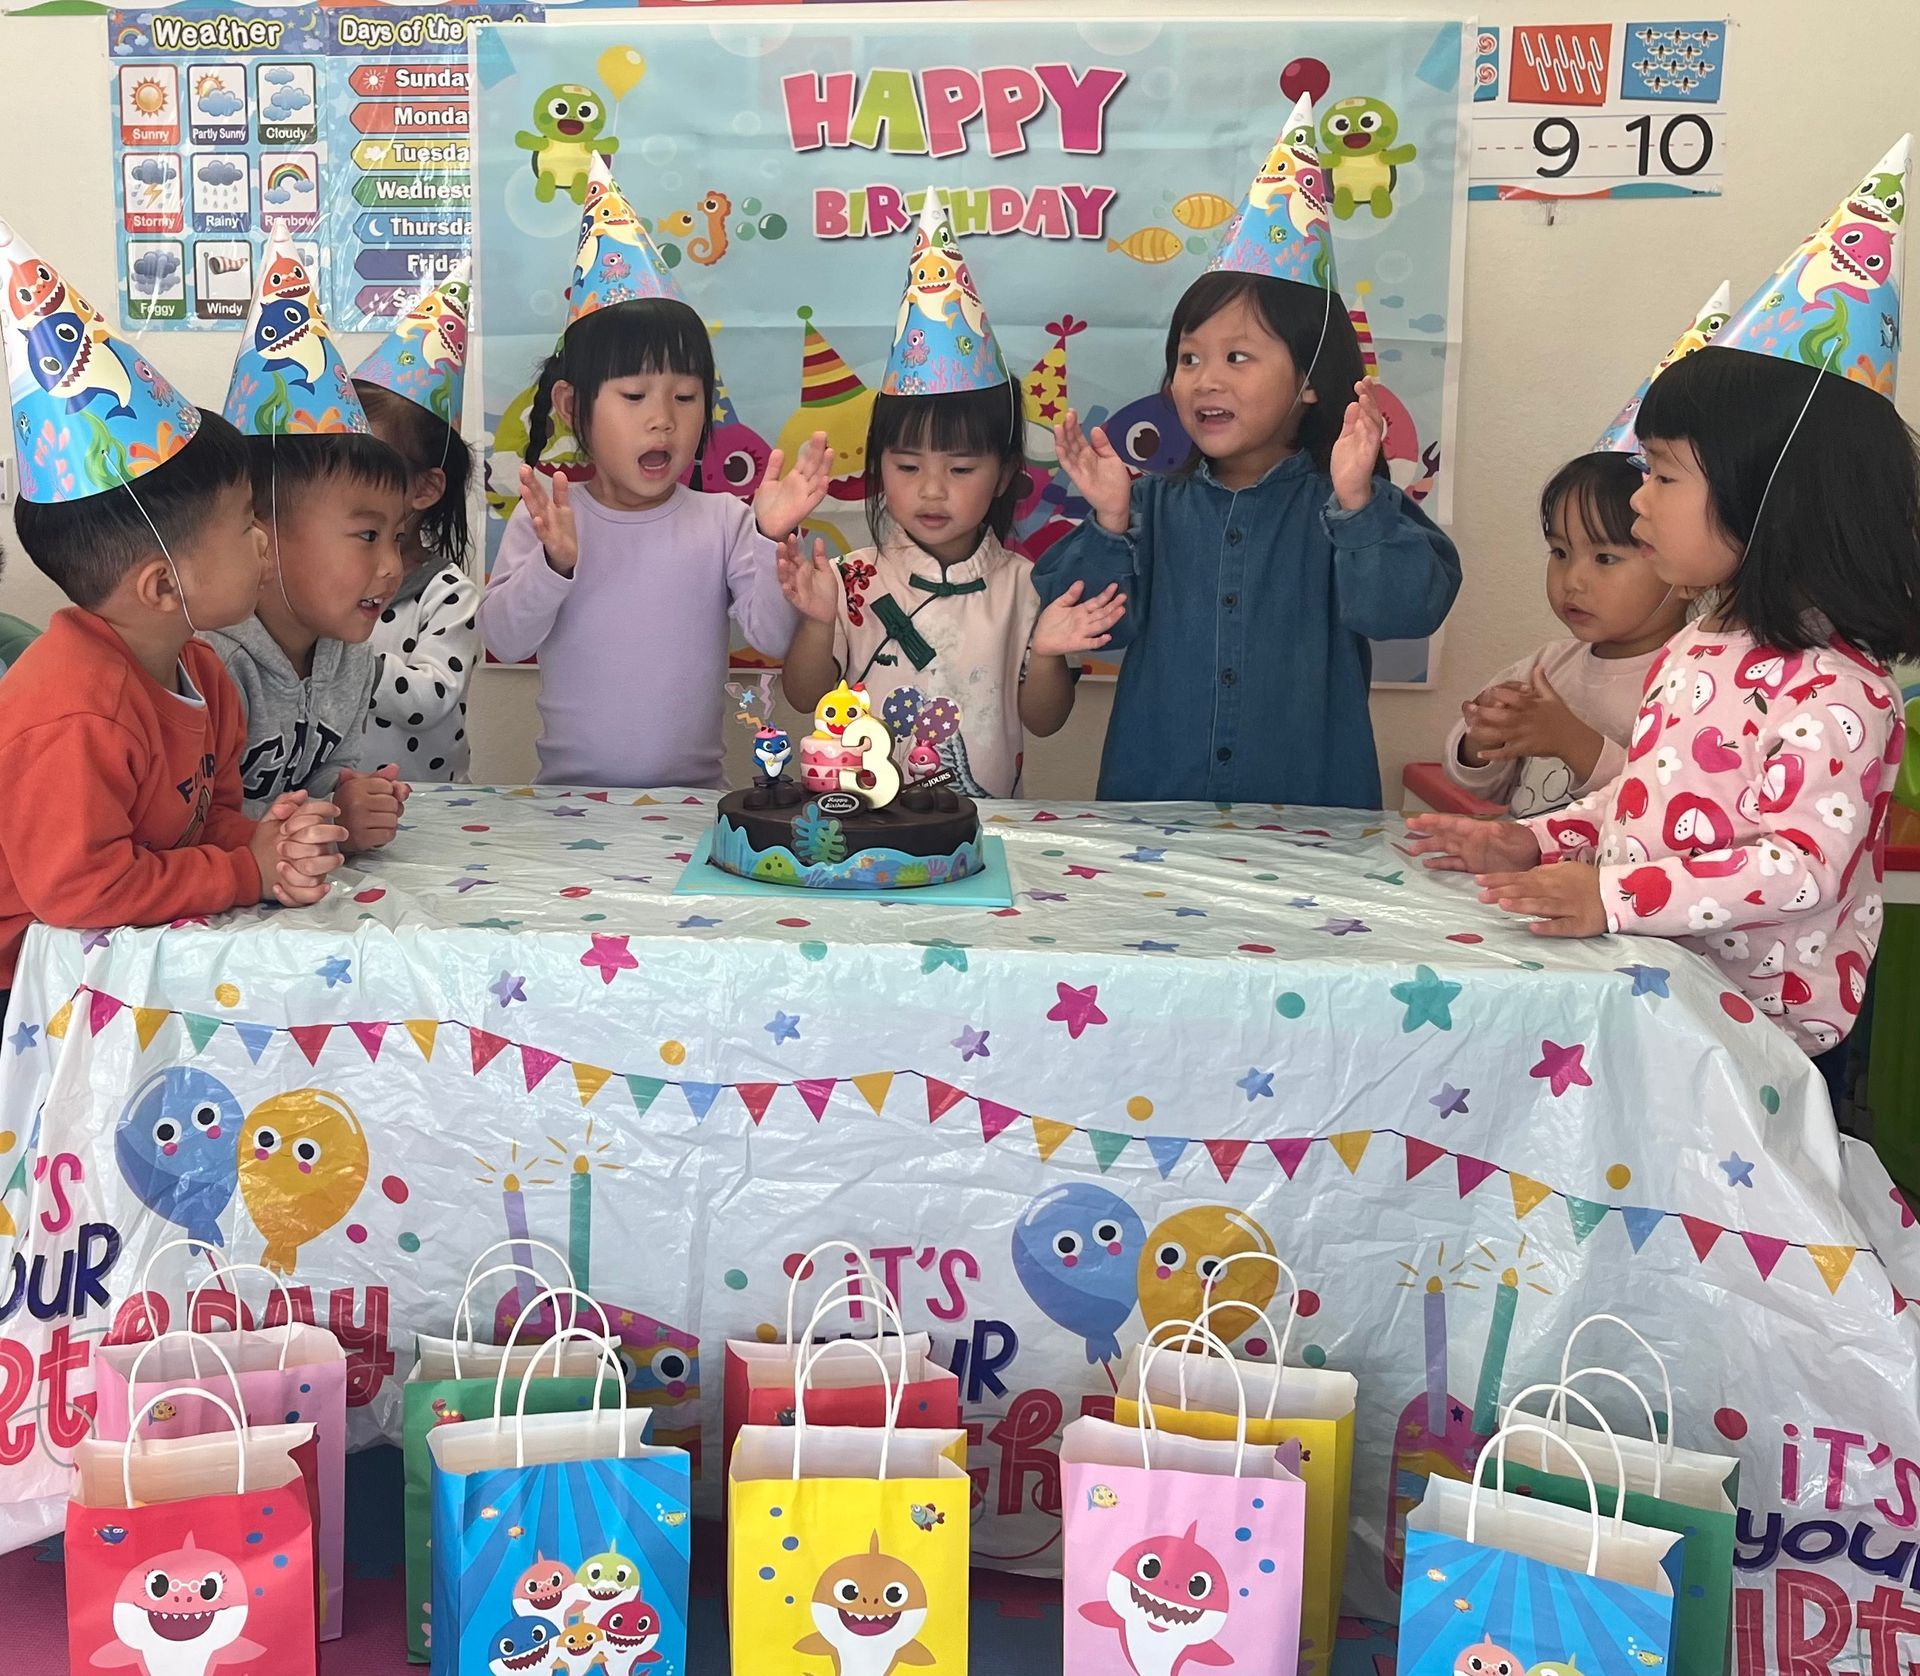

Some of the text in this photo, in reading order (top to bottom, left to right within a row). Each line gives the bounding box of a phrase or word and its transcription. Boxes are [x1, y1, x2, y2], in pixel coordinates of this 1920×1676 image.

[153, 18, 282, 48] Weather
[341, 14, 464, 47] Days of the
[394, 106, 470, 126] Monda
[781, 63, 1126, 158] HAPPY
[133, 128, 169, 141] Sunny
[192, 127, 247, 141] Partly Sunny
[265, 127, 307, 141] Cloudy
[392, 143, 470, 163] Tuesda
[1533, 113, 1713, 178] 9 10
[133, 215, 176, 228] Stormy
[206, 215, 239, 228] Rainy
[141, 303, 175, 316] Foggy
[206, 302, 243, 316] Windy
[838, 713, 904, 810] 3
